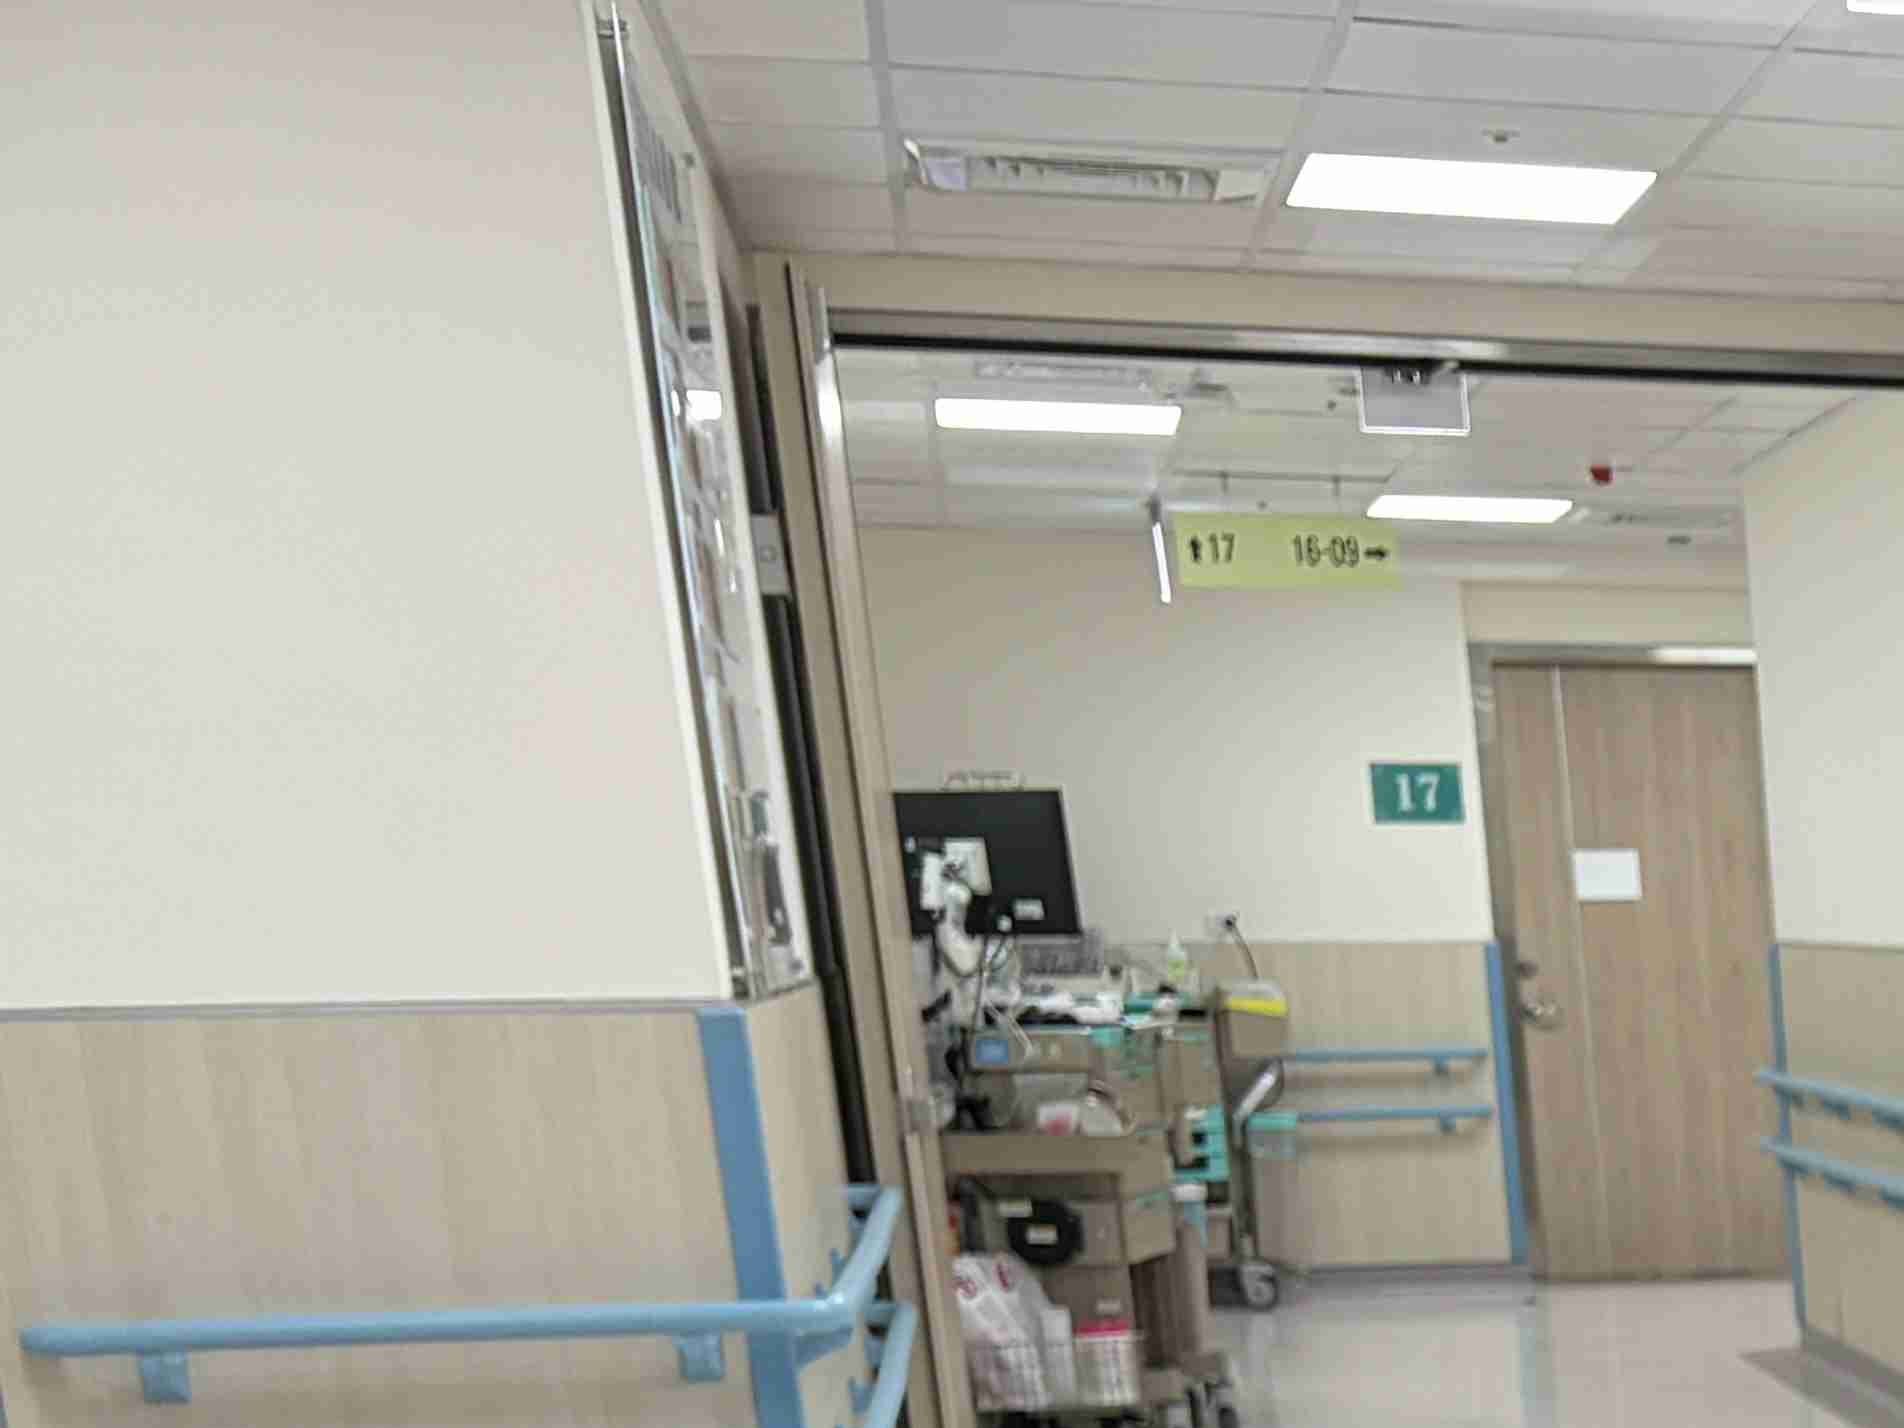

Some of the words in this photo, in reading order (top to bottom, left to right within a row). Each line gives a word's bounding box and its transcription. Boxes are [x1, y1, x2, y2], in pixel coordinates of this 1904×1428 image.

[1208, 532, 1236, 564] 17
[1293, 533, 1361, 567] 16-09
[1396, 773, 1441, 813] 17
